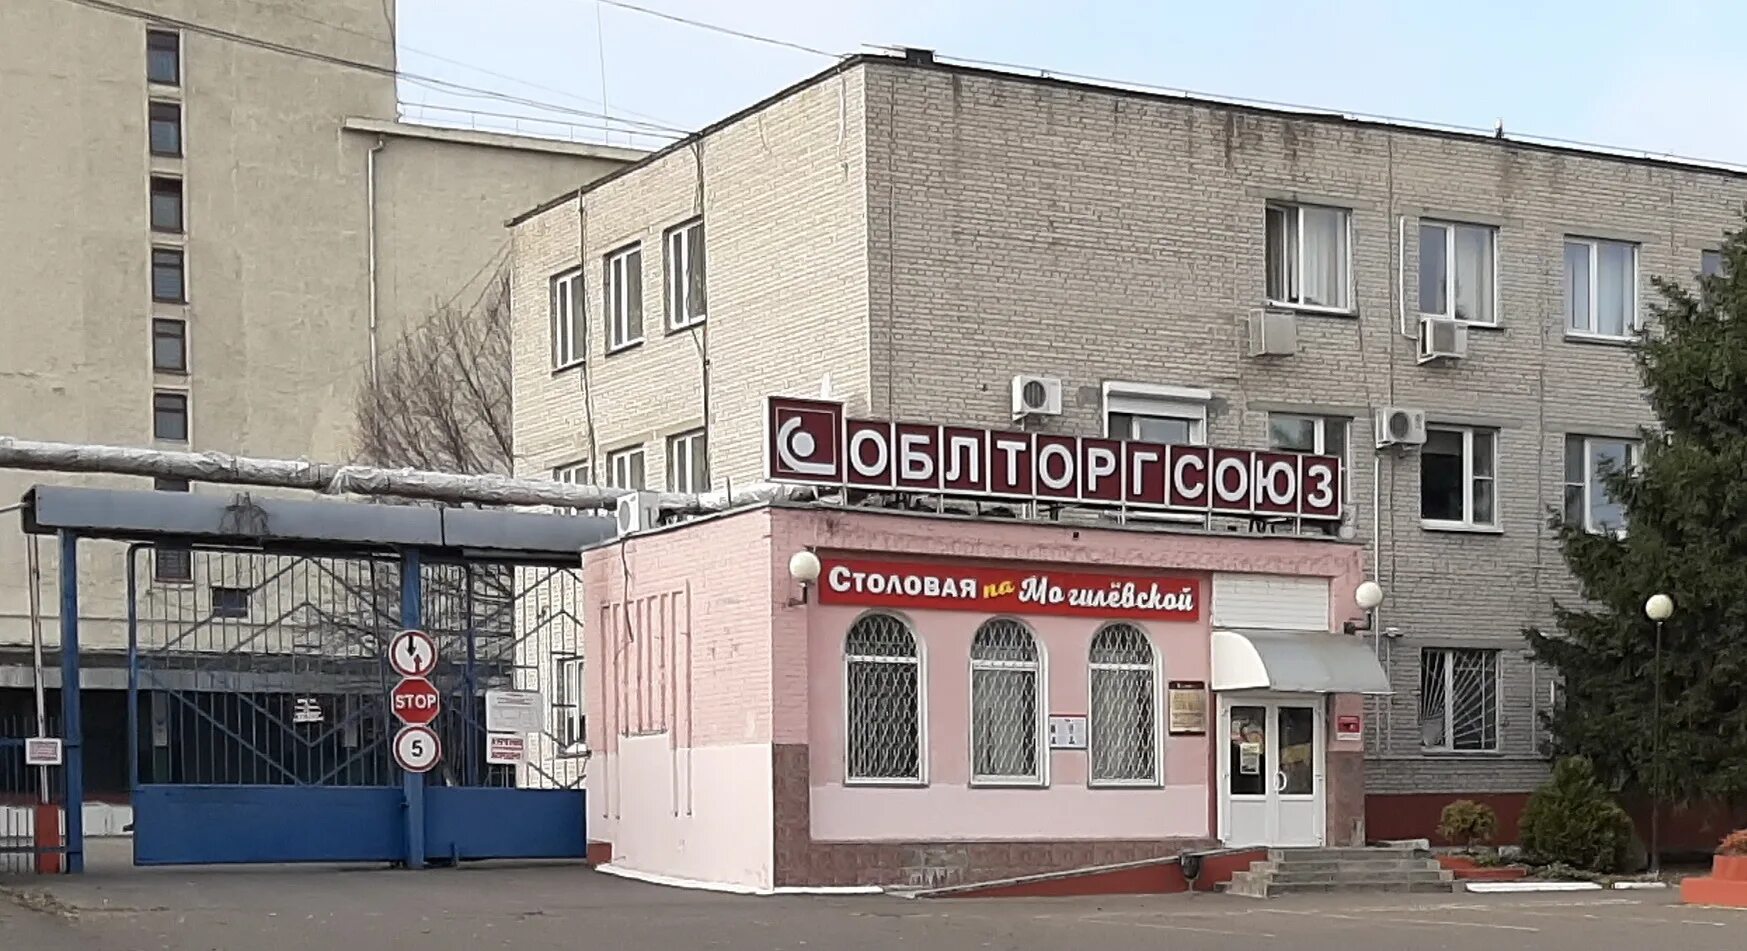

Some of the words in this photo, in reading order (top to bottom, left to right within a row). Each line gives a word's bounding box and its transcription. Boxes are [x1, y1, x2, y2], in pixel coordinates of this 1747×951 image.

[850, 429, 1333, 508] ОБЛТОРГСОЮЗ
[395, 694, 436, 709] STOP
[411, 740, 423, 757] 5
